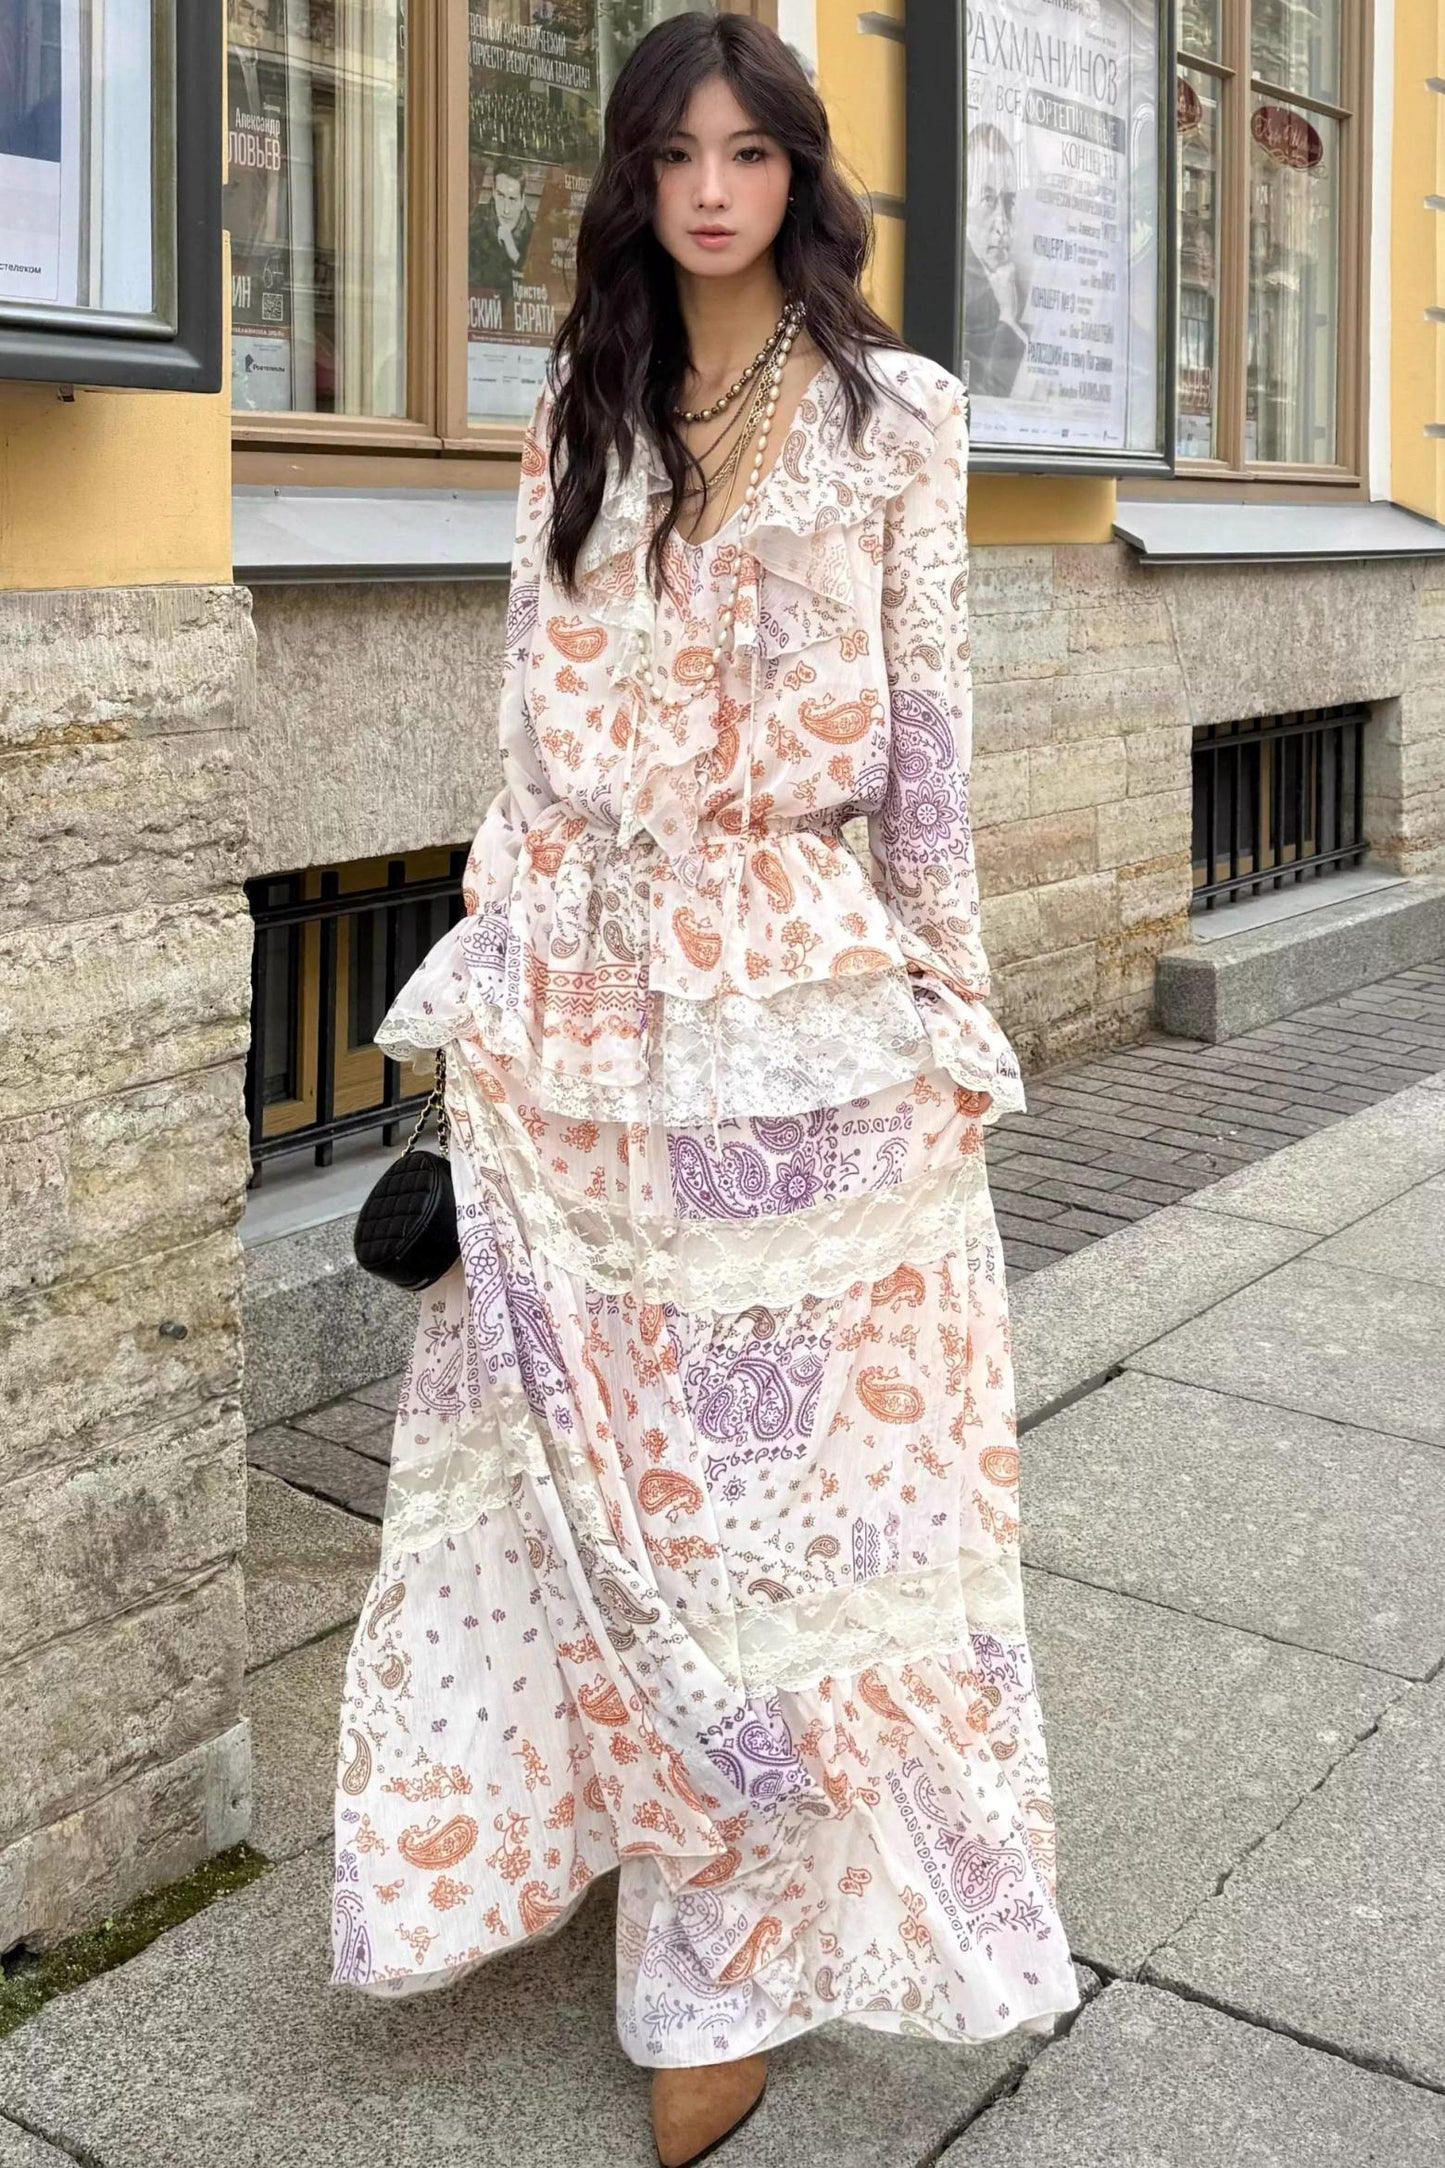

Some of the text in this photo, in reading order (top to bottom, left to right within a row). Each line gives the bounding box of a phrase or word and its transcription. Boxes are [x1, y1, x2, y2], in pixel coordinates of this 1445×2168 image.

[503, 21, 566, 57] АКАДЕМИЧЕСКИЙ
[472, 41, 505, 70] ОРКЕСТР
[506, 49, 554, 82] РЕСПУБЛИКИ
[554, 60, 591, 89] ТАТАРСТАН
[996, 85, 1021, 118] ВСЕ
[235, 107, 280, 138] Александр
[1061, 141, 1117, 180] КОНЦЕРТЫ
[512, 280, 548, 304] Кристоф
[514, 301, 556, 335] БАРАТИ
